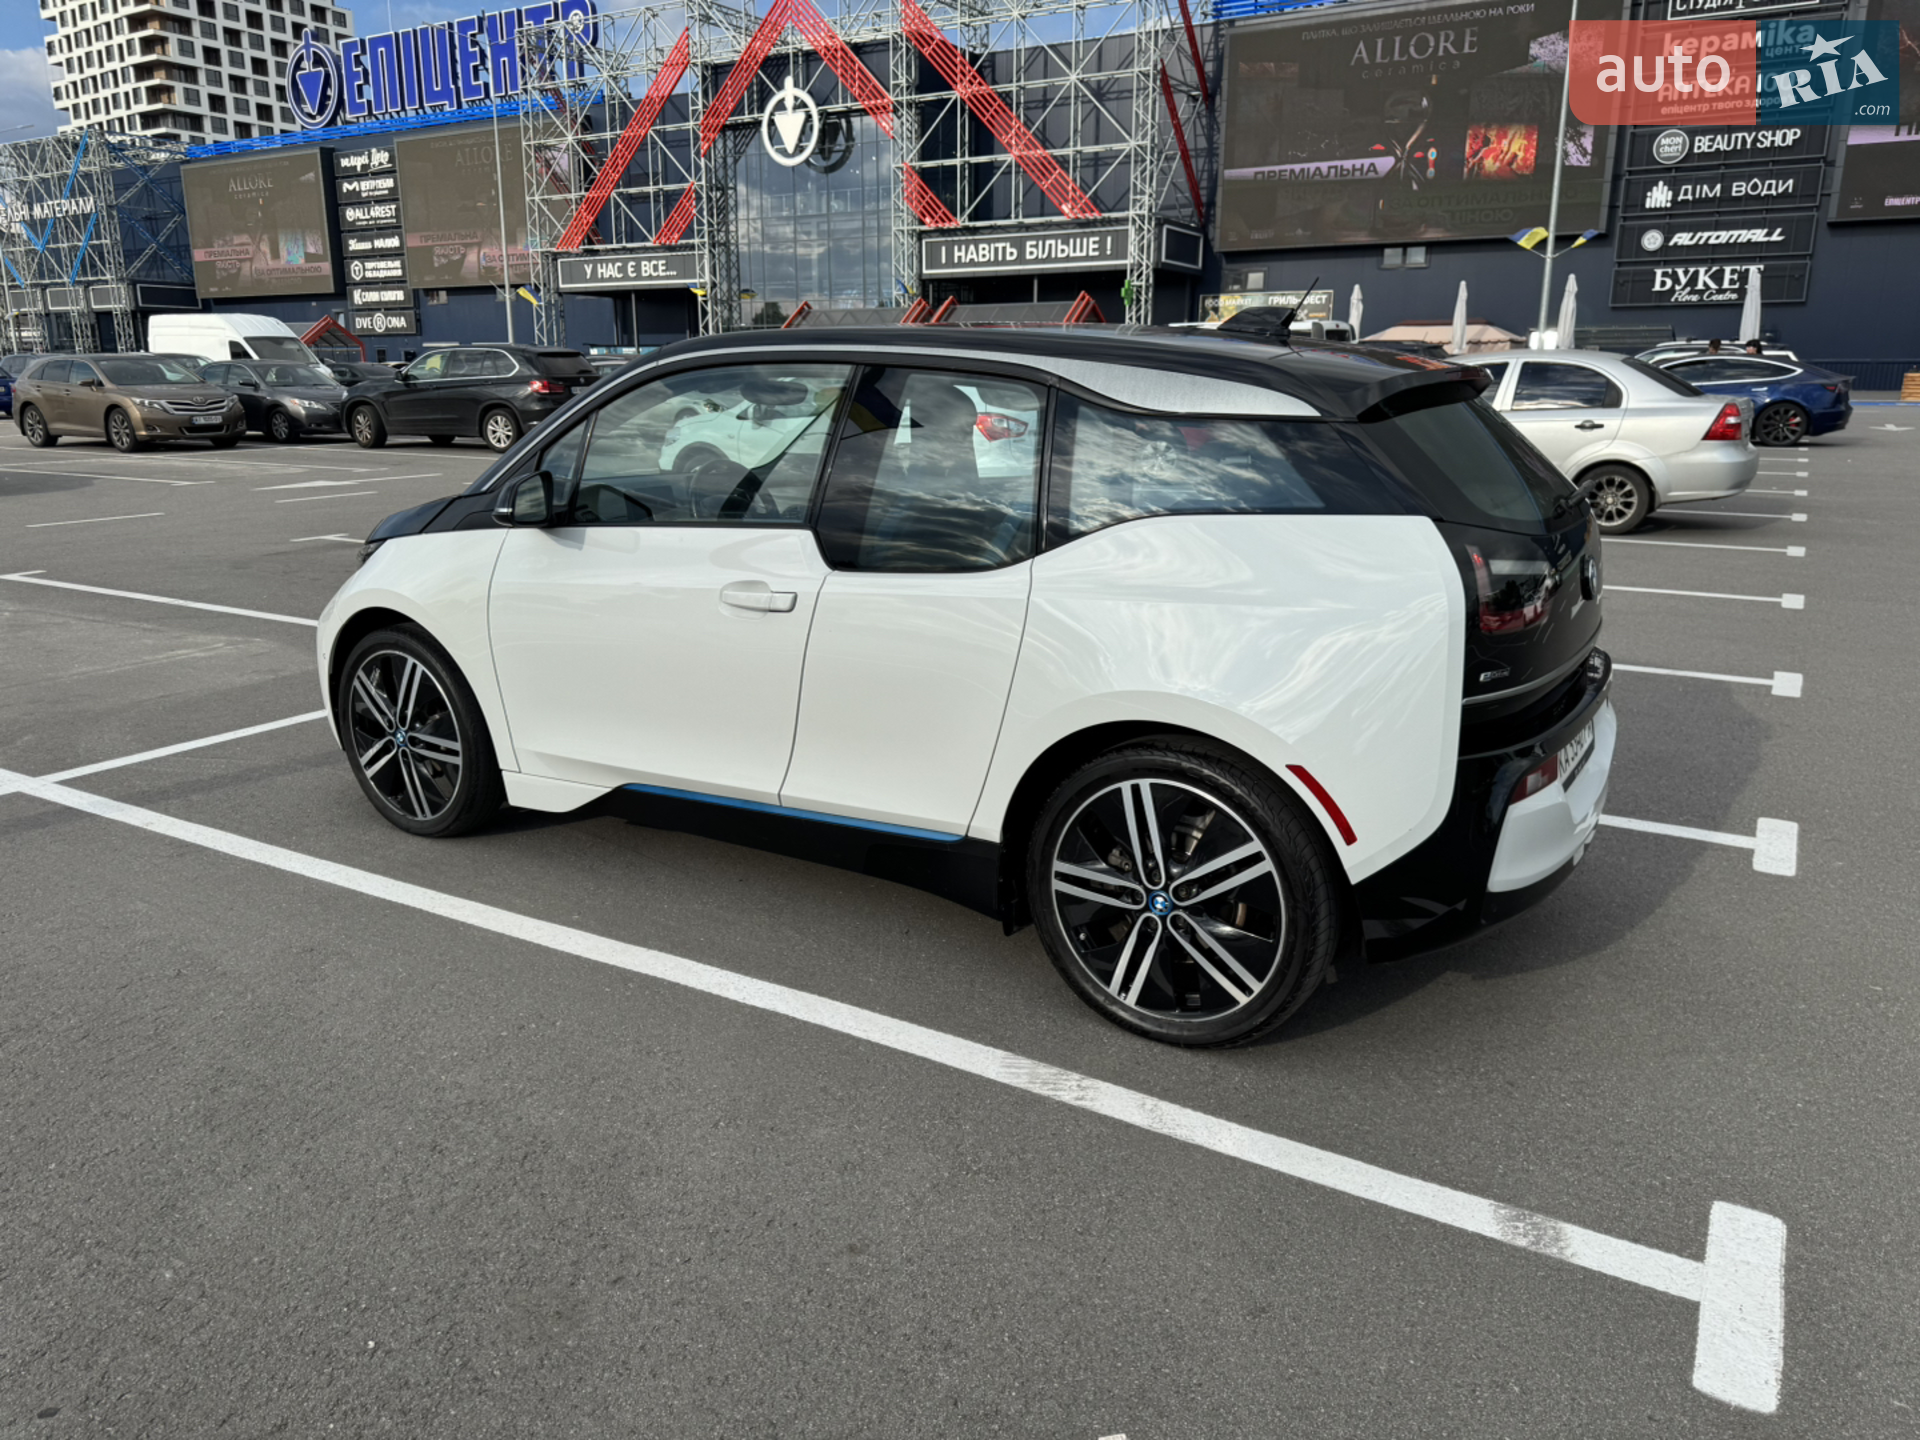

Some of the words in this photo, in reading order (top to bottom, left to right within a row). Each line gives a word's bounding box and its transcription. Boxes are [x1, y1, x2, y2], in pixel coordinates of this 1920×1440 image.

[1489, 7, 1504, 17] НА
[1507, 3, 1535, 15] РОКИ
[1350, 27, 1479, 66] ALLORE
[340, 0, 598, 118] ЕПІЦЕНТР
[1362, 59, 1461, 79] ceramica
[1712, 98, 1743, 110] твого
[1661, 136, 1683, 145] MON
[1693, 131, 1756, 154] BEAUTY
[1757, 128, 1801, 148] SHOP
[455, 144, 513, 167] ALLOE
[1253, 162, 1380, 181] ПРЕМІАЛЬНА
[229, 172, 274, 192] ALLORE
[1677, 183, 1721, 202] ДІМ
[1731, 178, 1794, 197] ВОДИ
[33, 196, 96, 220] МАТЕРІАЛИ
[355, 204, 397, 220] ALL4REST
[420, 231, 479, 243] ПРЕМІАЛЬНА
[1668, 228, 1786, 246] AUTOMALL
[954, 242, 1018, 263] НАВІТЬ
[1025, 236, 1100, 260] БІЛЬШЕ
[584, 263, 593, 279] У
[597, 262, 624, 279] НАС
[627, 260, 637, 278] Є
[641, 259, 677, 277] ВСЕ...
[1652, 264, 1764, 292] БУКЕТ
[1703, 289, 1739, 301] Centre
